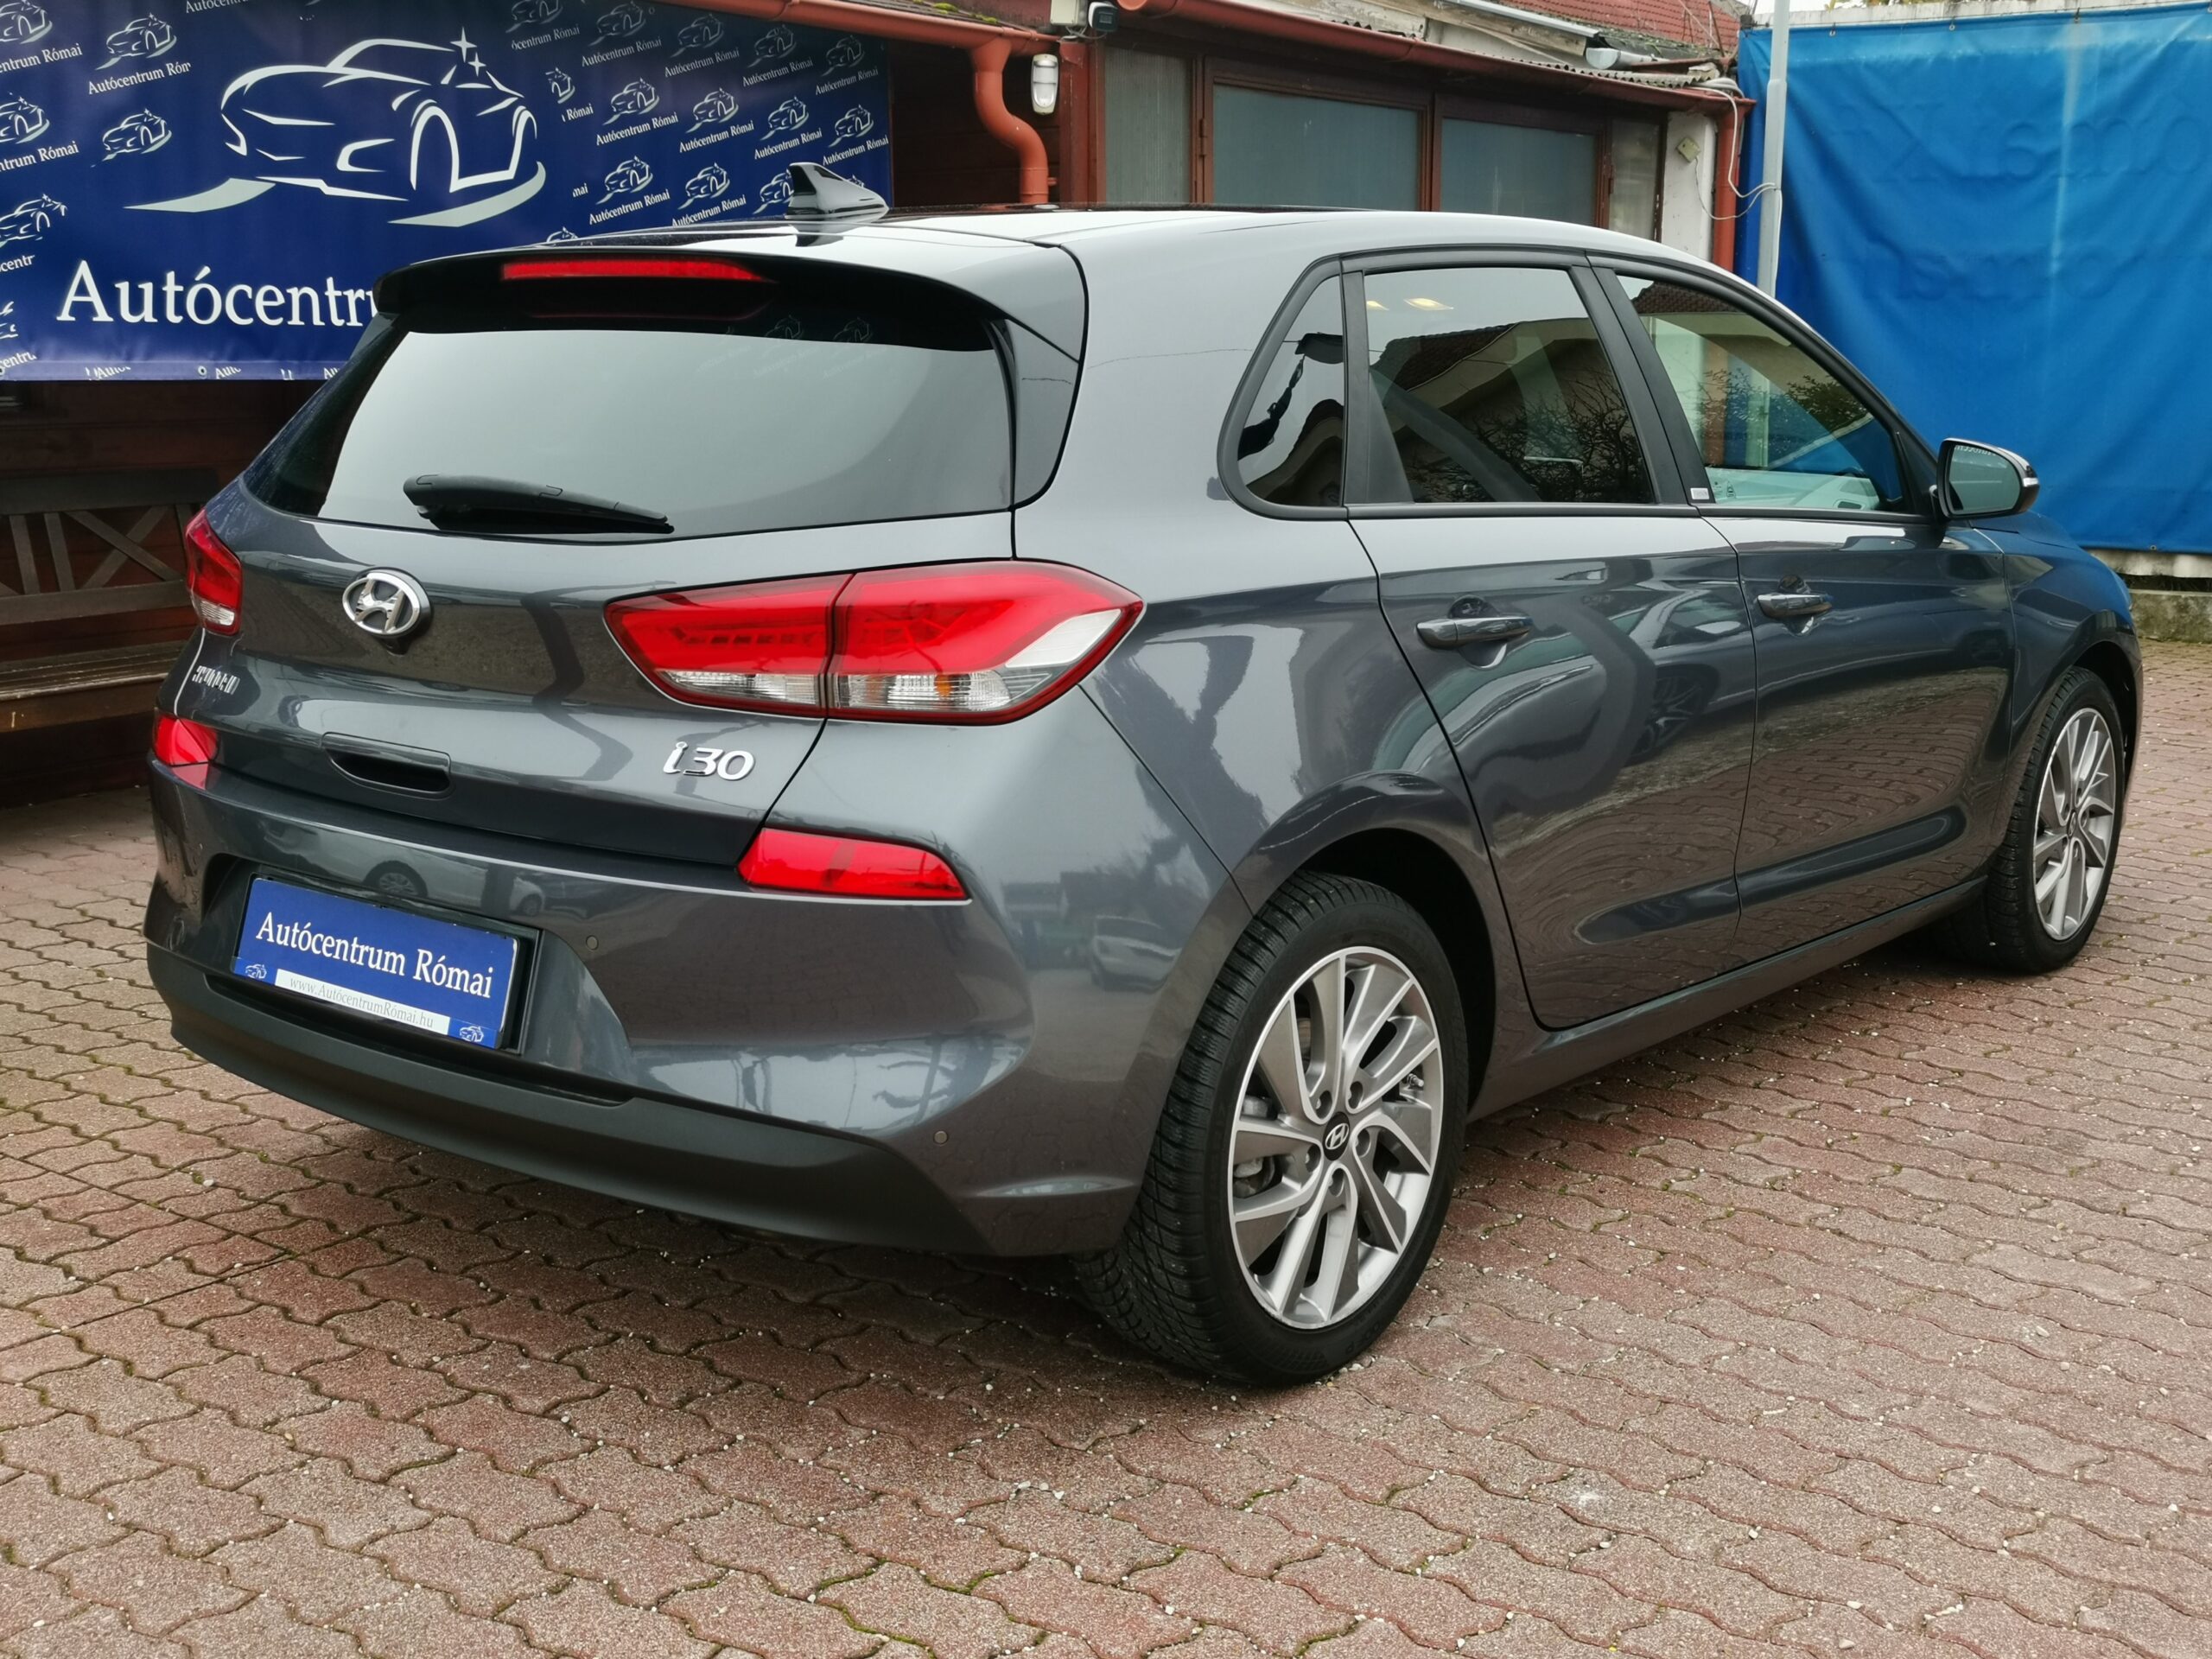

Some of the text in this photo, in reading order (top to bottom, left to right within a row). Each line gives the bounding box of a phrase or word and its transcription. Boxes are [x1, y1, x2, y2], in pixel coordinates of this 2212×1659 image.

[553, 23, 580, 41] Római
[41, 43, 82, 63] Római
[582, 36, 663, 67] Autócentrum Római
[664, 47, 740, 78] Autócentrum Római
[89, 69, 164, 94] Autócentrum
[742, 57, 813, 87] Autócentrum Római
[815, 66, 879, 95] Autócentrum Római
[566, 103, 594, 121] Római
[596, 111, 678, 146] Autócentrum Római
[679, 120, 754, 153] Autócentrum Római
[754, 128, 823, 160] Autócentrum Római
[37, 141, 79, 162] Római
[823, 135, 889, 166] Autócentrum Római
[589, 188, 671, 225] Autócentrum Római
[671, 194, 747, 226] Autócentrum Római
[663, 741, 754, 781] i30
[256, 912, 493, 998] Autócentrum Római
[290, 977, 433, 1027] www.AutócentrumRómai.hu
